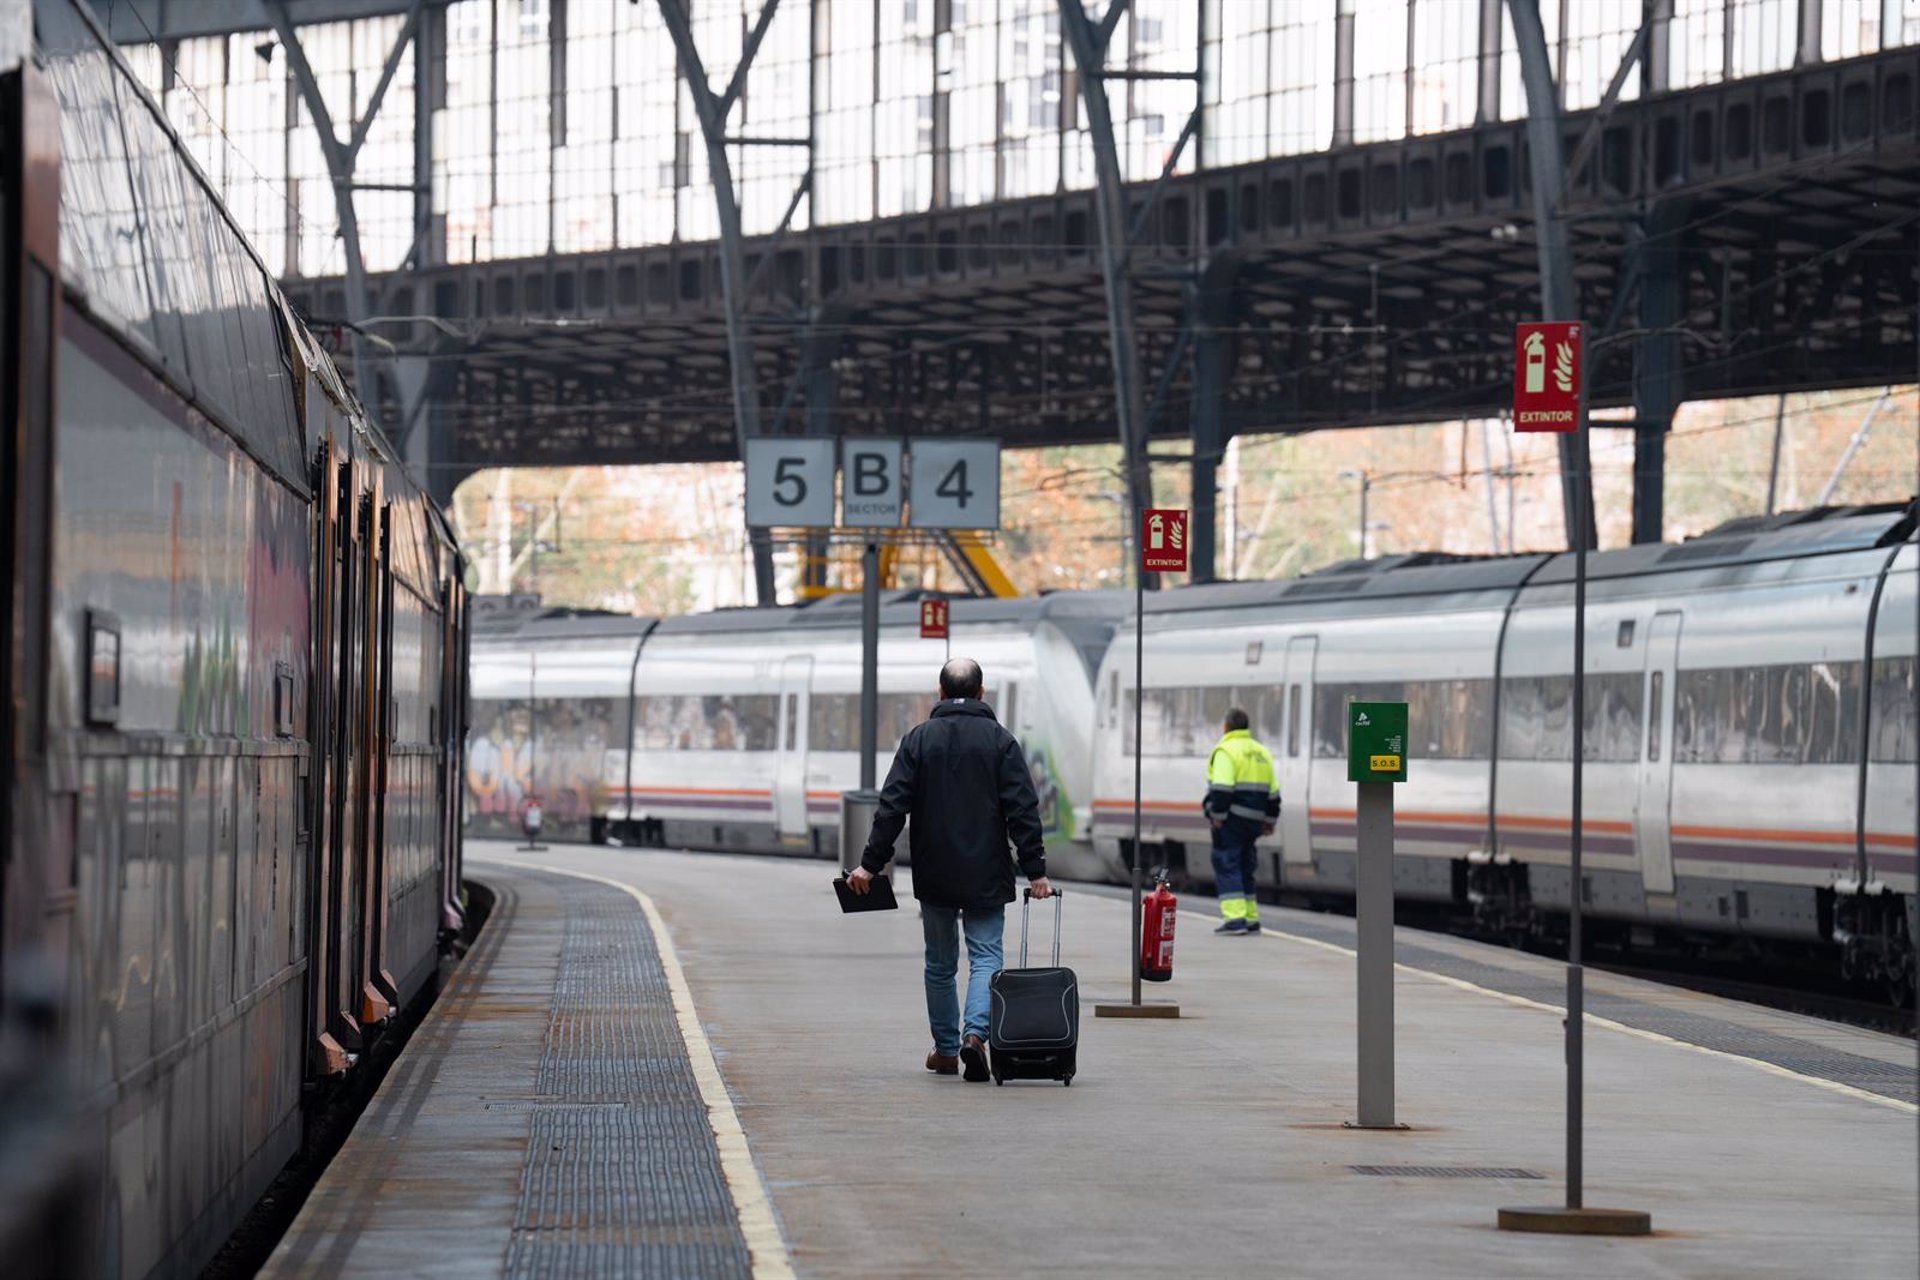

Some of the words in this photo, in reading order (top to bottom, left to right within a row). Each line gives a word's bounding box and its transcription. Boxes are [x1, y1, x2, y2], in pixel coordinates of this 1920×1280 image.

[1520, 411, 1573, 422] EXTINTOR
[772, 457, 808, 507] 5
[853, 453, 890, 496] B
[935, 459, 974, 509] 4
[848, 504, 896, 515] SECTOR
[1147, 559, 1183, 567] EXTINTOR
